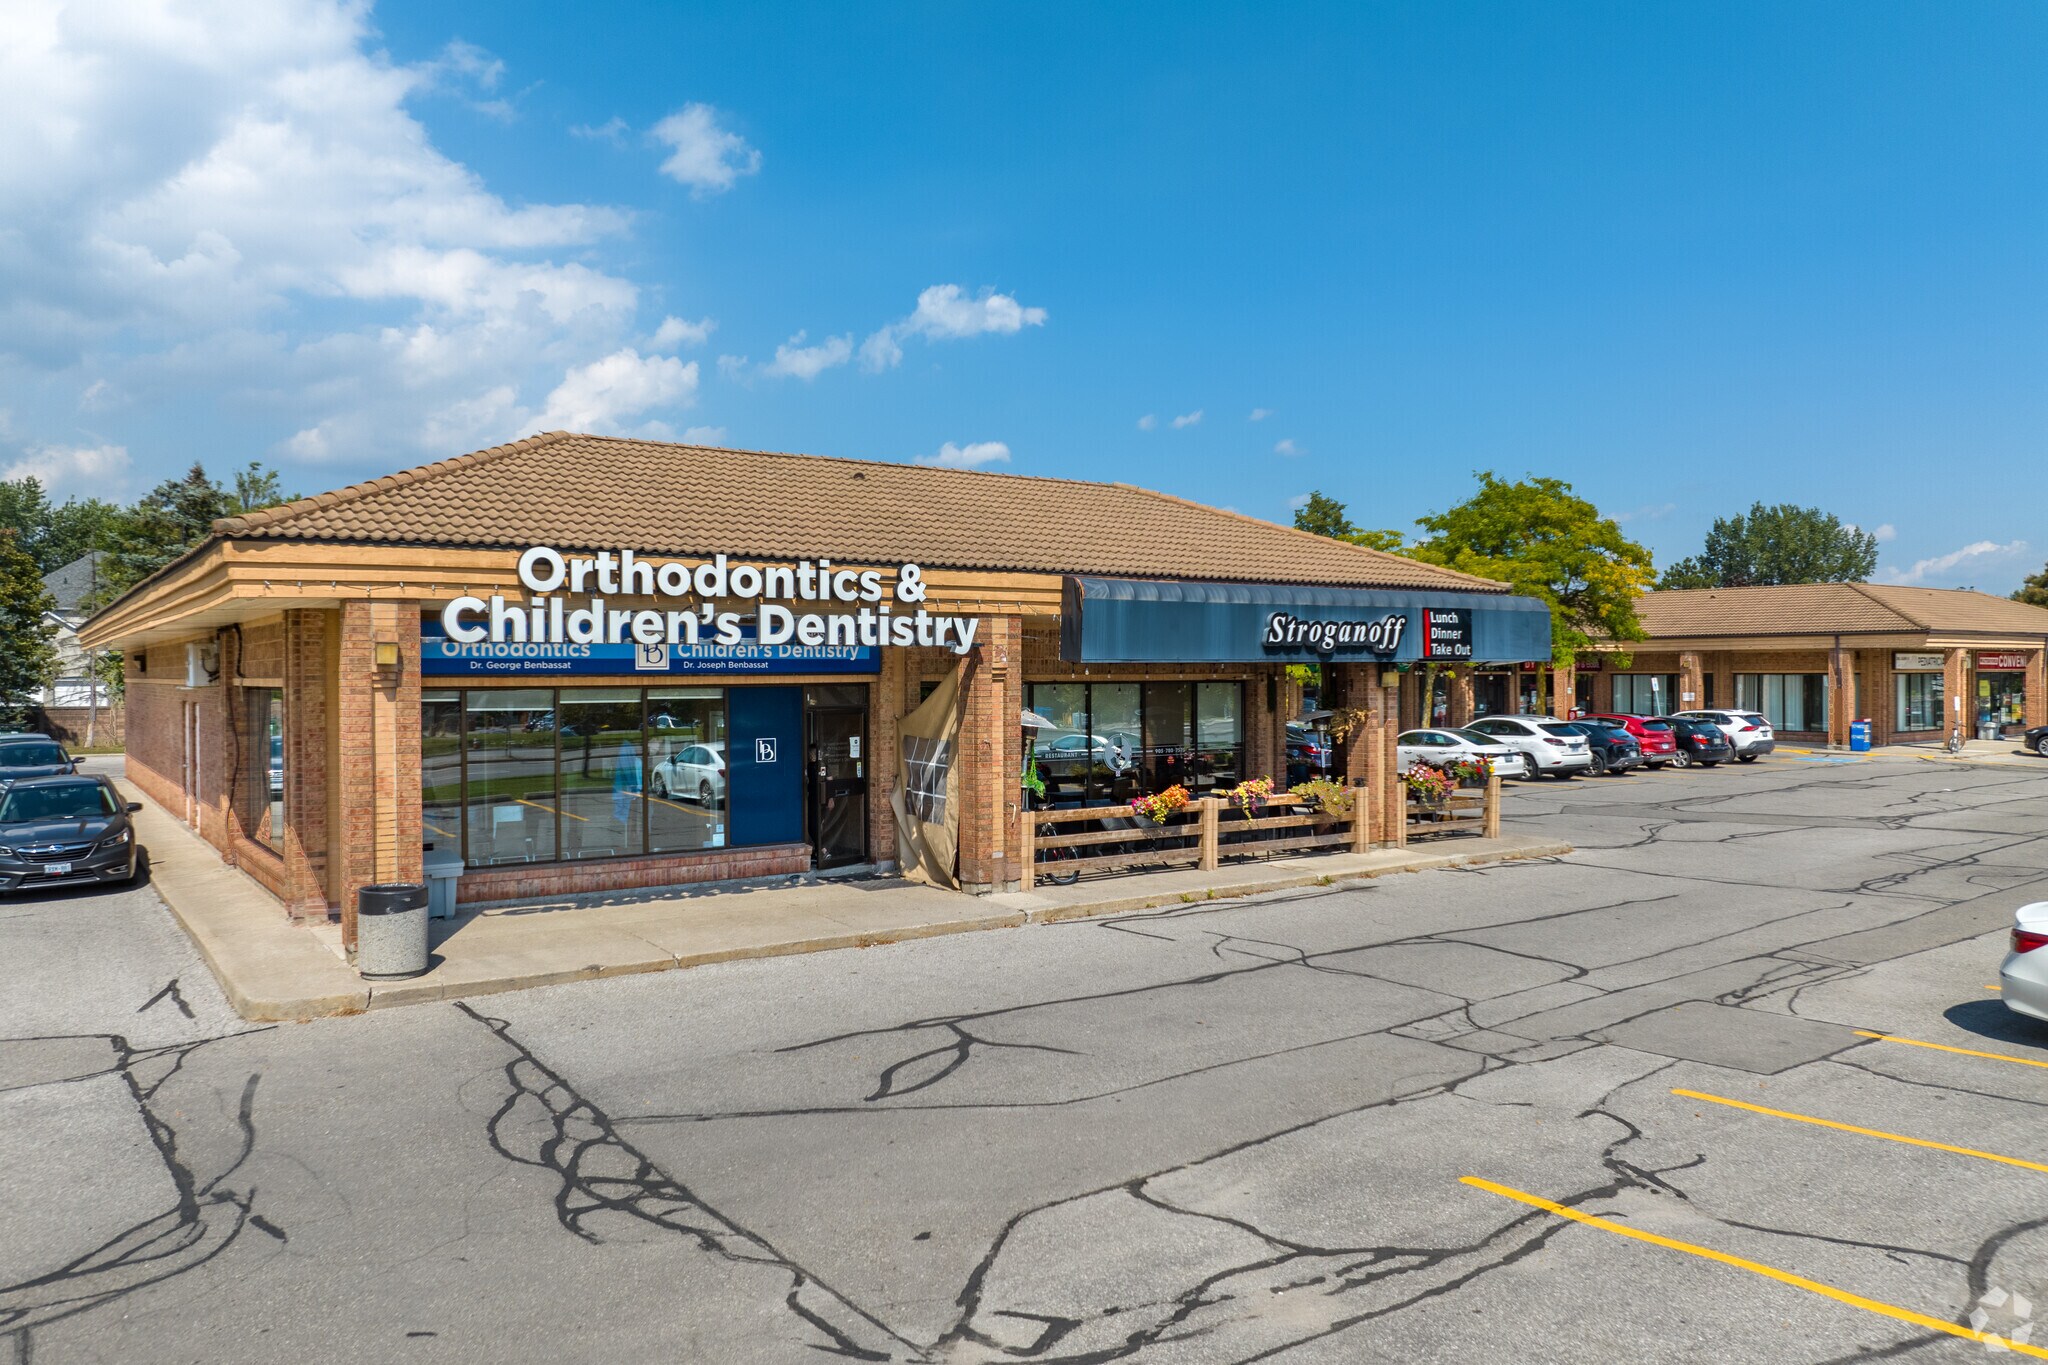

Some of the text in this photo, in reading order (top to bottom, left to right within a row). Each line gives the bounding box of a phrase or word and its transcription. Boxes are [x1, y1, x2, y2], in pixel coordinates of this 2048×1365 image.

[518, 546, 928, 602] Orthodontics &
[1429, 611, 1458, 624] Lunch
[757, 603, 979, 655] Dentistry
[1267, 614, 1406, 650] Stroganoff
[1430, 628, 1463, 640] Dinner
[441, 642, 591, 657] Orthodontics
[778, 645, 859, 661] Dentistry
[1430, 643, 1472, 656] Take Out
[470, 661, 571, 671] Dr. George Benbassat
[683, 661, 769, 671] Dr. Joseph Benbassat
